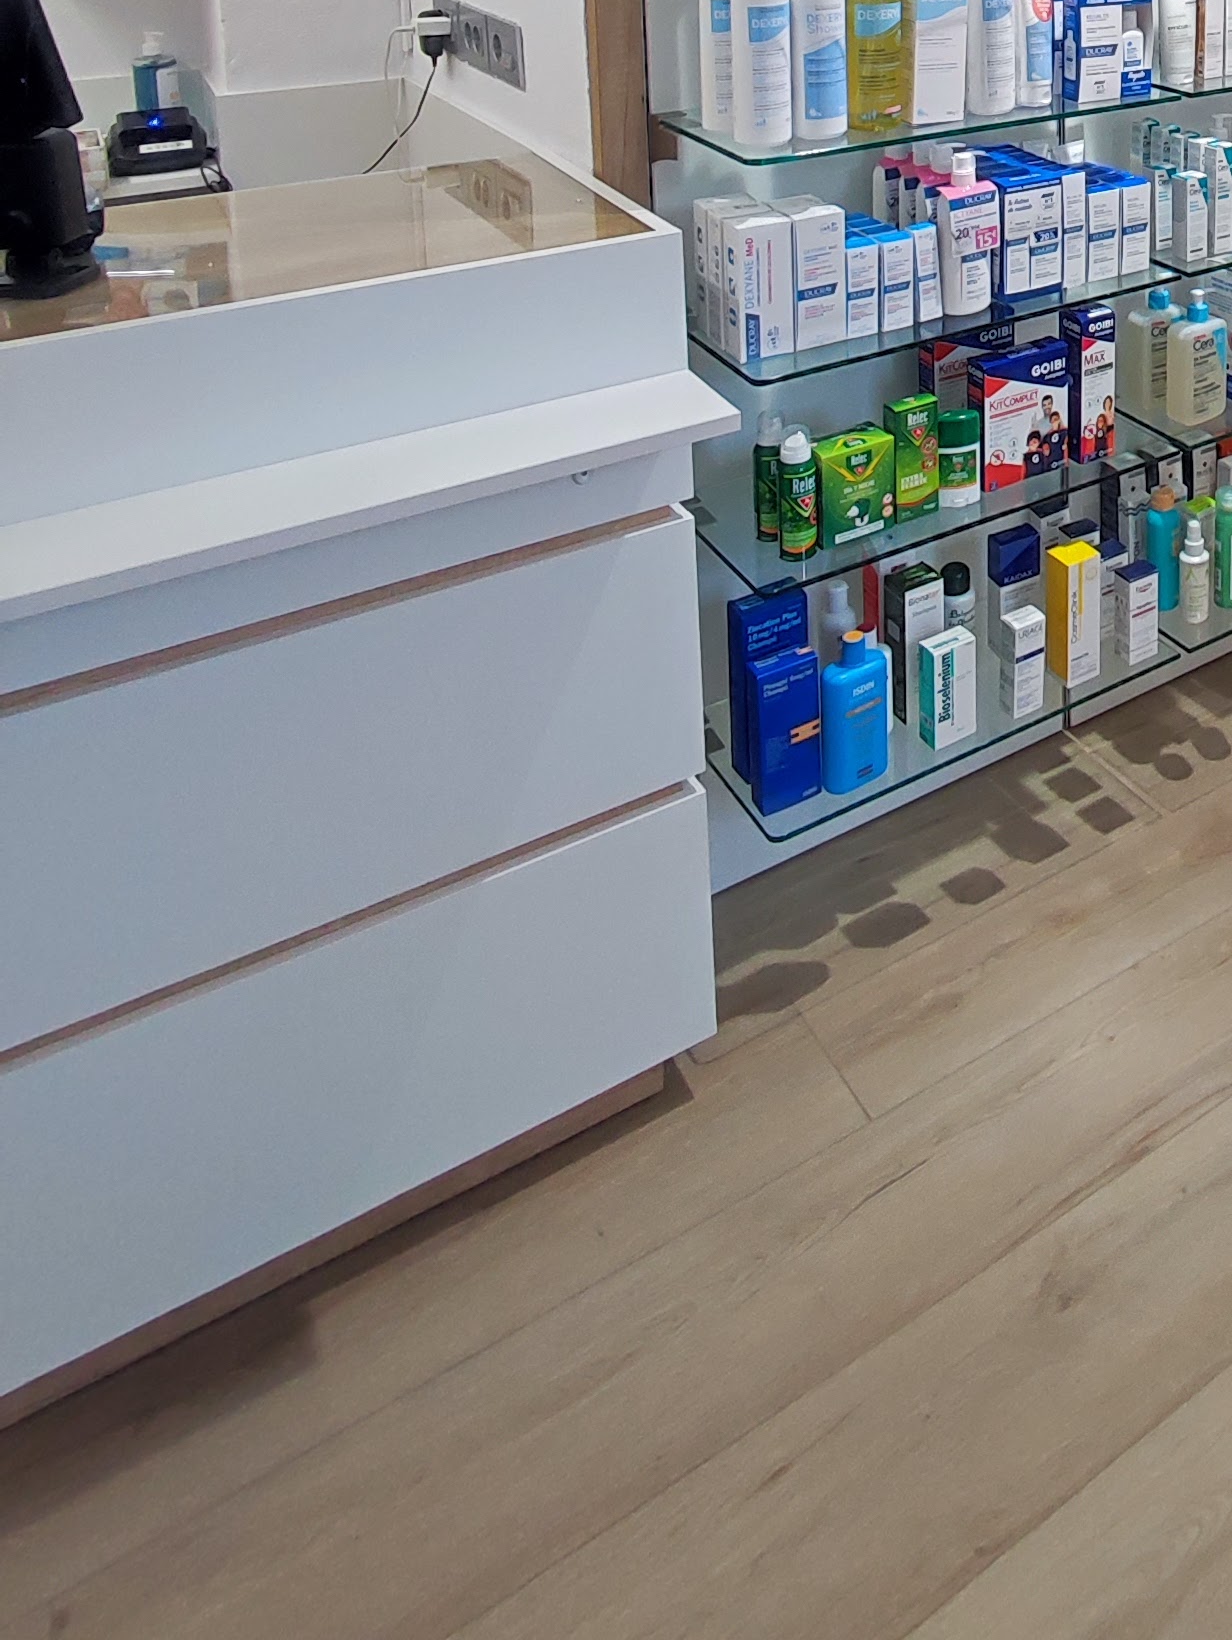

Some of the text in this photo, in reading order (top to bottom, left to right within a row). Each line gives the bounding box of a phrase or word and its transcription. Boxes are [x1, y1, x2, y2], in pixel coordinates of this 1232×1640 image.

[1086, 46, 1114, 56] DUCRAY
[964, 192, 993, 206] DUCRAY
[744, 259, 755, 311] DEXYANE
[1089, 319, 1114, 333] GOIBI
[1031, 357, 1066, 377] GOIBI
[907, 411, 928, 427] Relec
[1003, 569, 1034, 584] KAIDAX
[782, 610, 798, 622] Plus
[853, 680, 875, 697] ISDIN
[938, 652, 950, 724] Bioselenium
